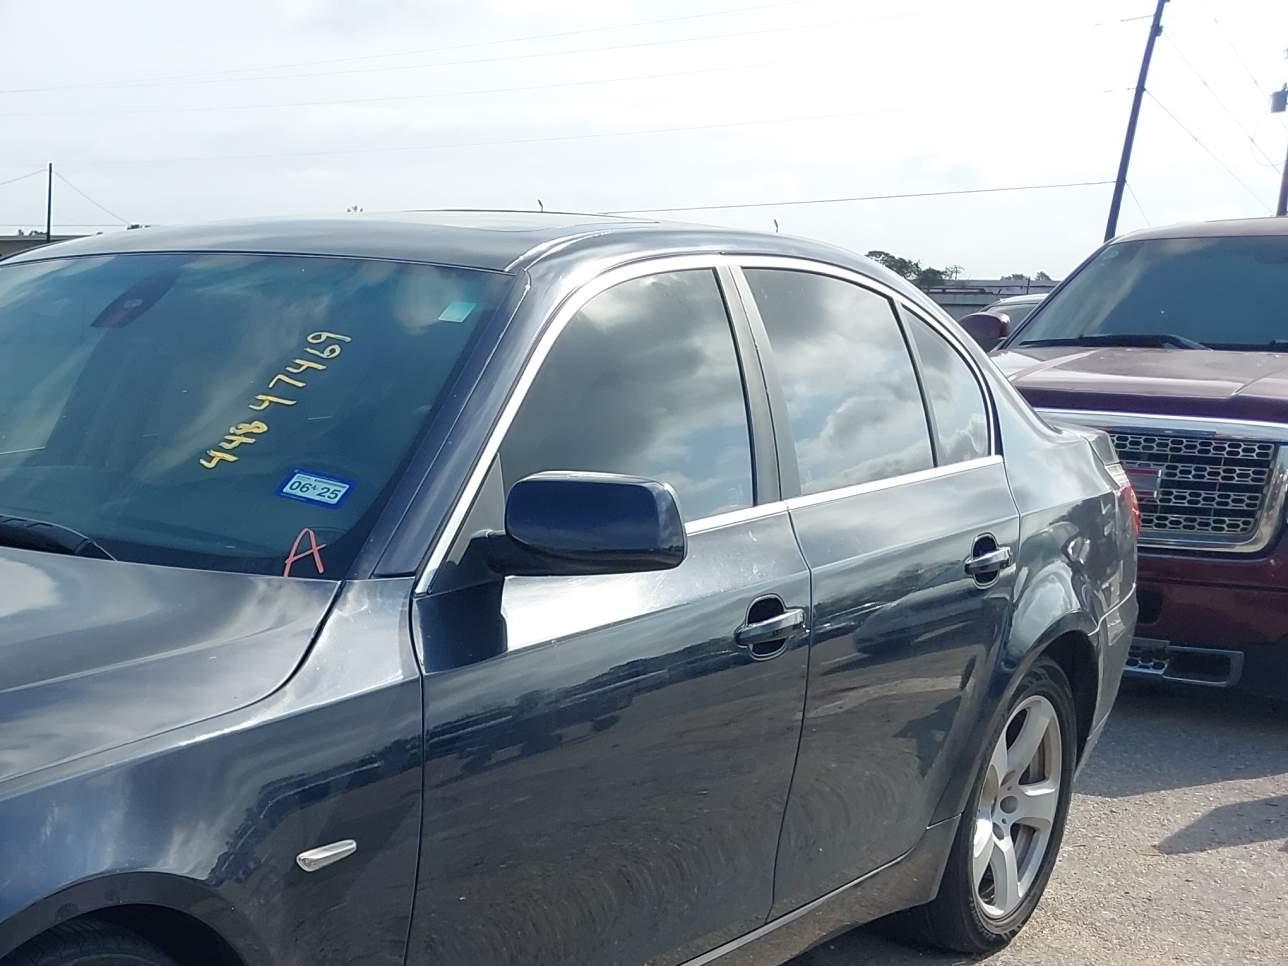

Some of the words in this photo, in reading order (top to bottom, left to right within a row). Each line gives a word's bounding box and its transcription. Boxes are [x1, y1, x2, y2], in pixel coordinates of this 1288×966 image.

[200, 331, 352, 468] 44847469
[289, 480, 313, 494] 06
[317, 486, 342, 500] 25
[283, 528, 327, 577] A
